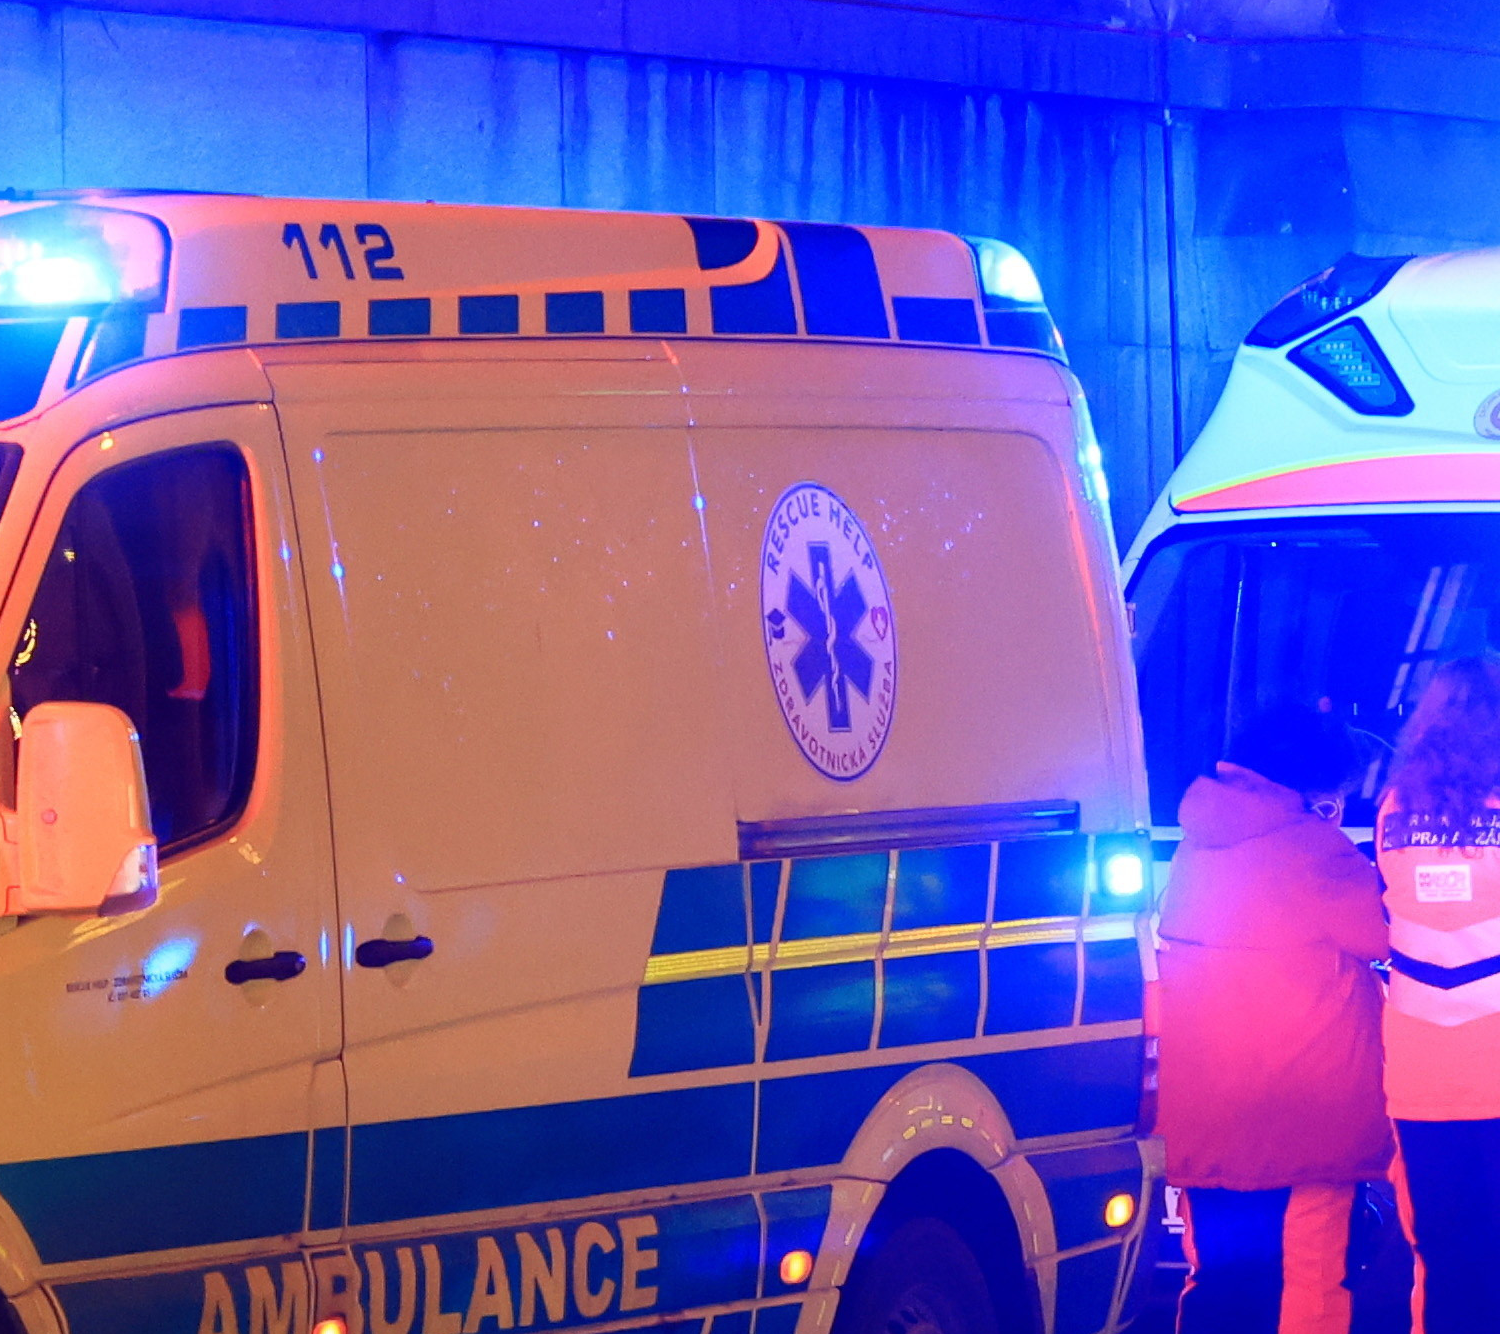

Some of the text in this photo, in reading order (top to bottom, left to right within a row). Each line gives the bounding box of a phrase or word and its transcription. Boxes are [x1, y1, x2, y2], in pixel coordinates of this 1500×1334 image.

[282, 222, 405, 281] 112
[766, 492, 873, 575] RESCUE HELP
